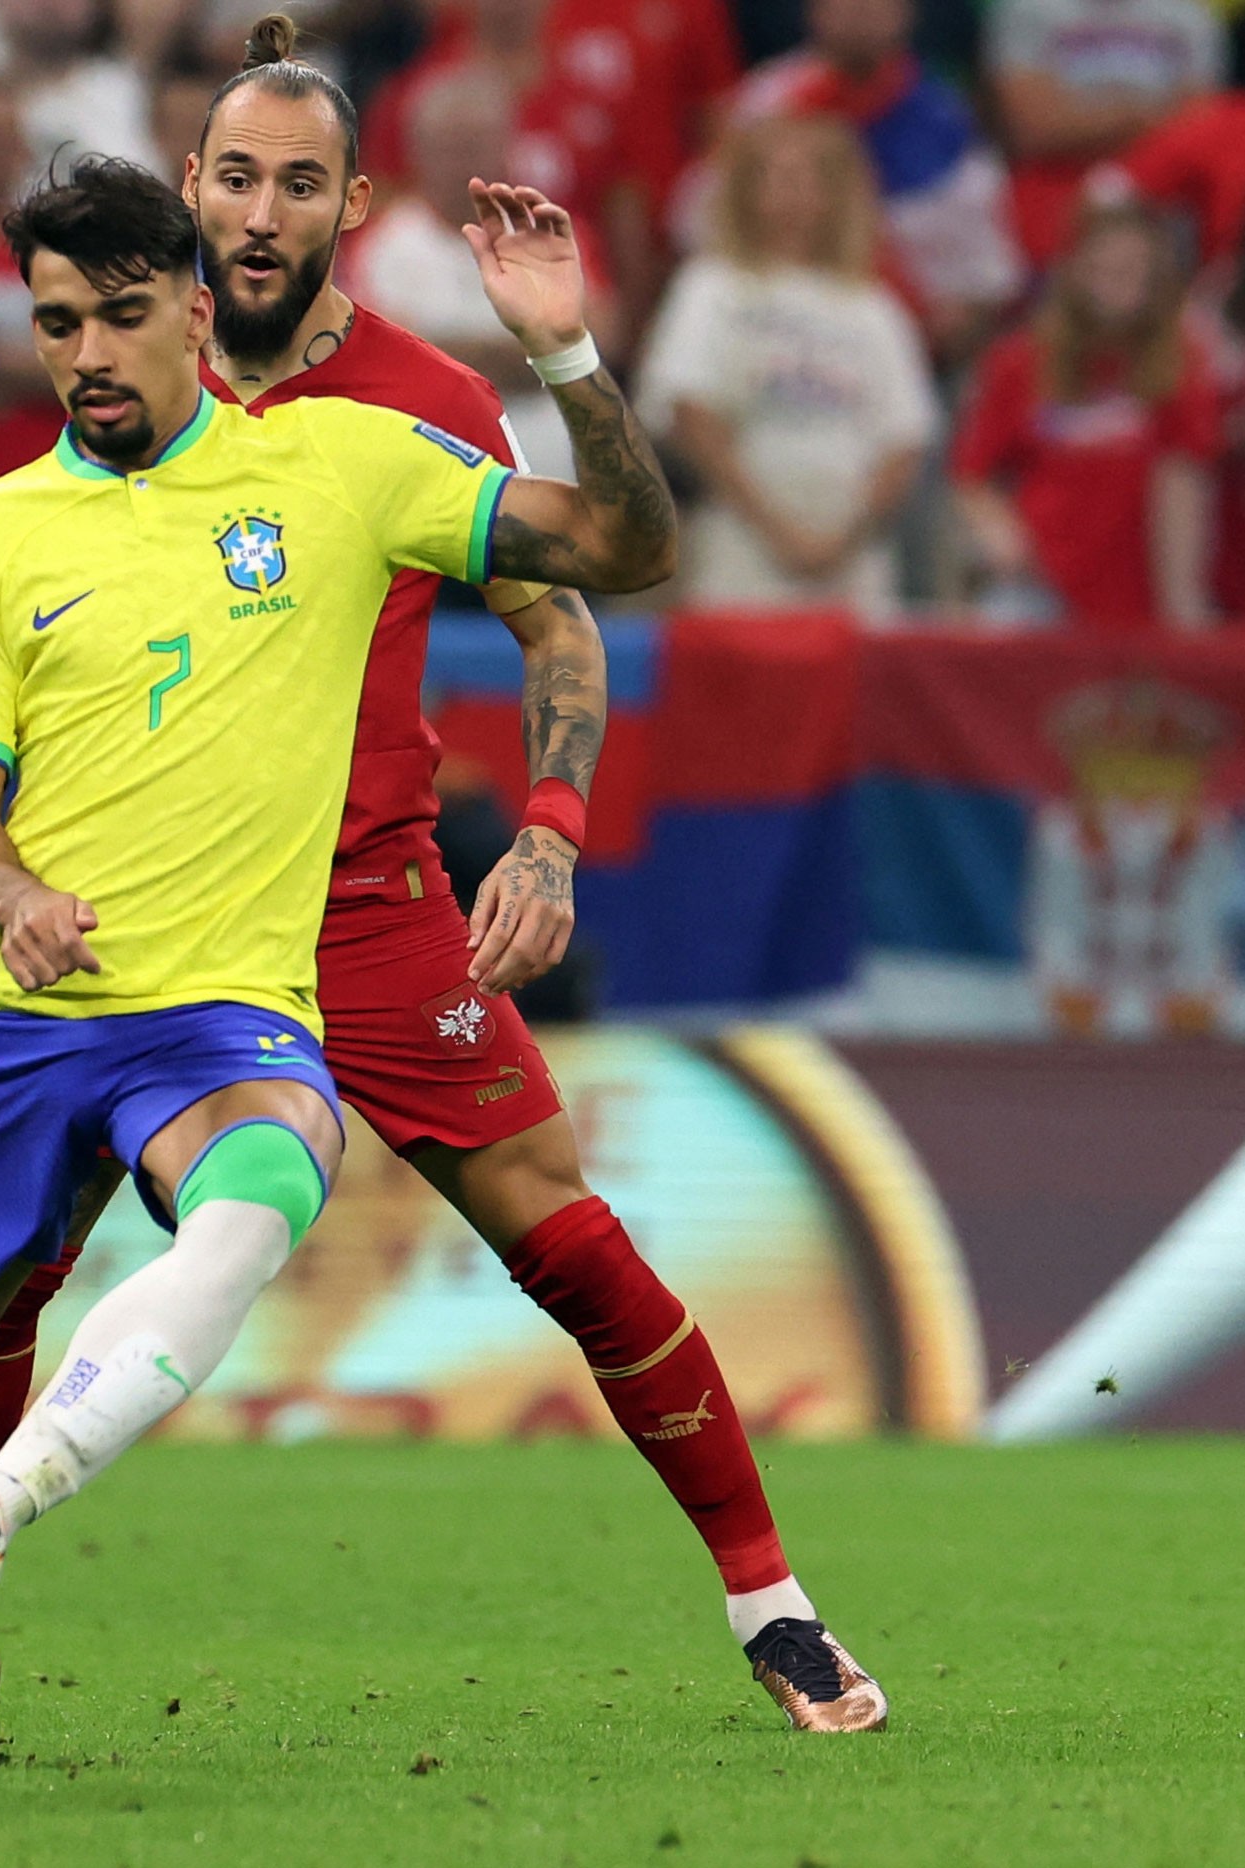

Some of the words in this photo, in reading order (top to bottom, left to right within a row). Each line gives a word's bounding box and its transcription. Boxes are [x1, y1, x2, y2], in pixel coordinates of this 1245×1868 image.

[229, 595, 297, 620] BRASIL
[147, 632, 191, 732] 7
[475, 1074, 524, 1106] PUMA
[46, 1357, 101, 1410] BRASIL
[642, 1418, 703, 1441] PUMA
